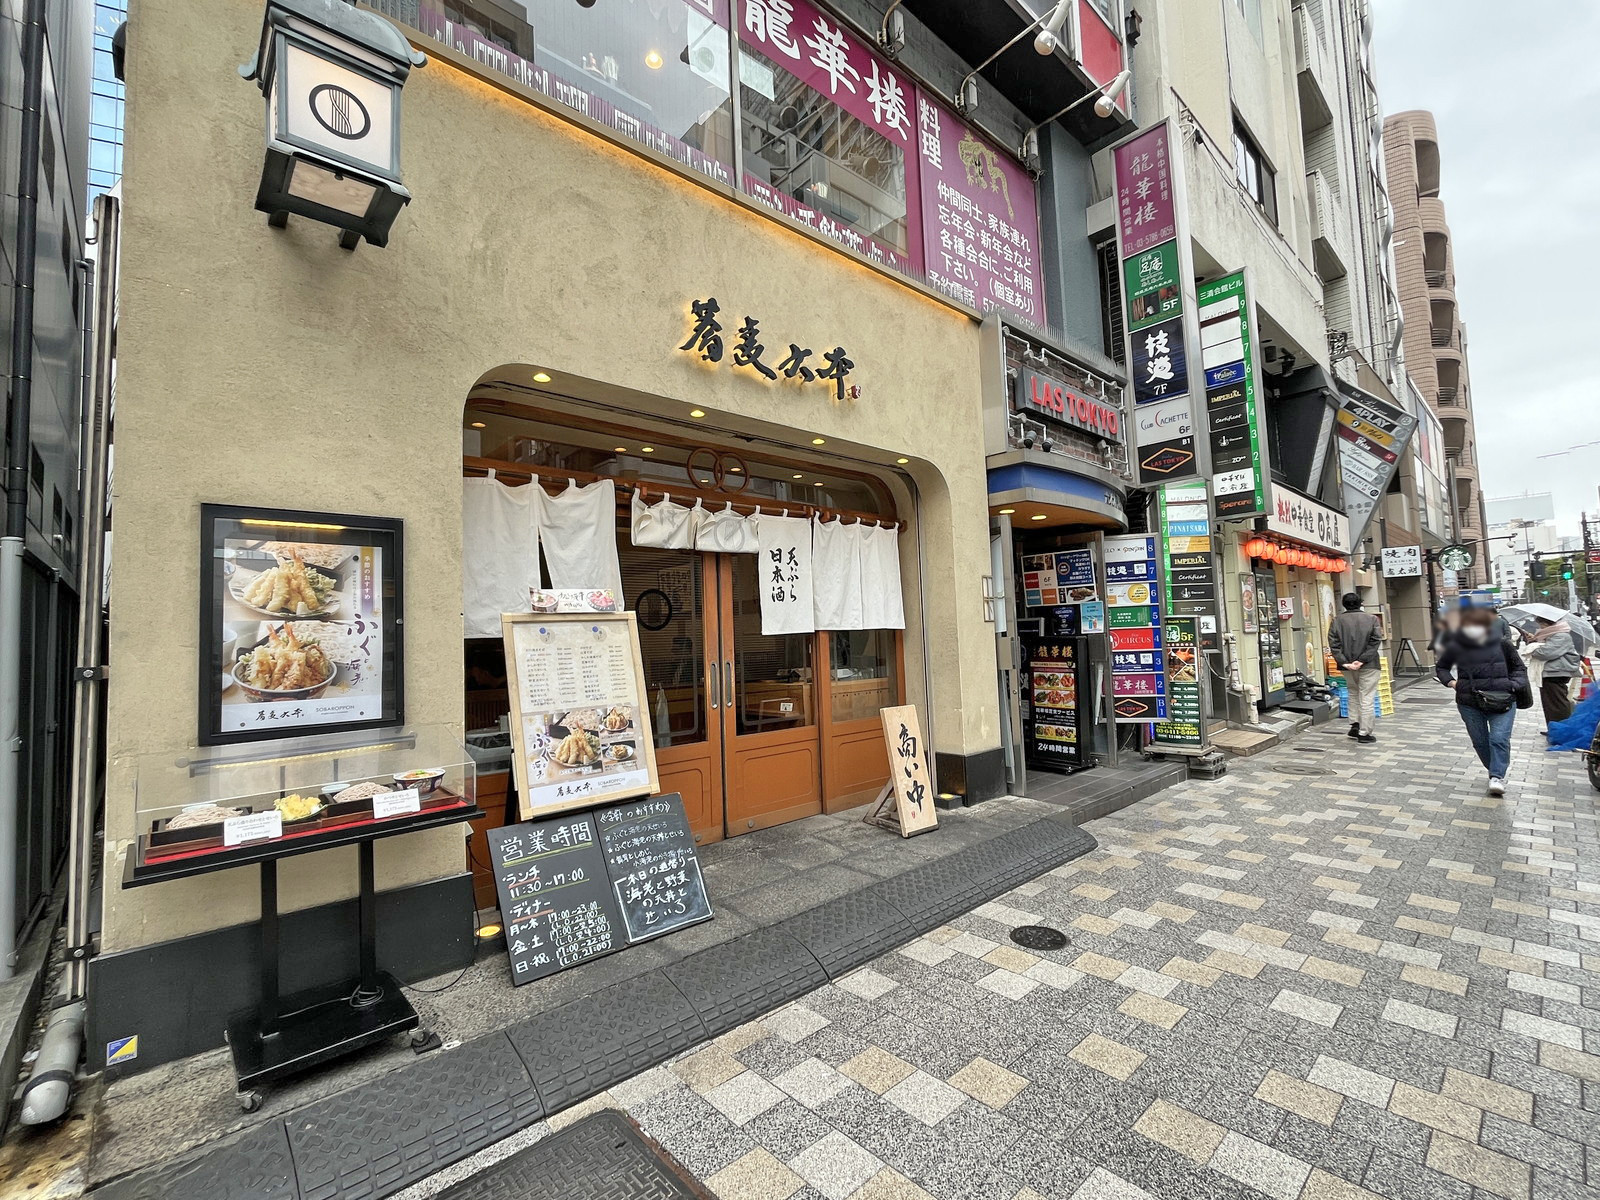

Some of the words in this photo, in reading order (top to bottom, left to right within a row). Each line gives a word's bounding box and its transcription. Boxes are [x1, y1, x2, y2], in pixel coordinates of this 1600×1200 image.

[919, 98, 942, 170] 料理
[1129, 152, 1158, 226] 龍華楼
[937, 180, 1030, 252] 仲間同士、家族連れ
[937, 204, 1032, 274] 忘年会・新年会など
[940, 229, 1033, 294] 各種会合に、ご利用
[940, 251, 979, 287] 下さい。
[1162, 298, 1179, 311] 5F
[1240, 299, 1246, 308] 9
[1242, 321, 1248, 330] 8
[1243, 342, 1249, 352] 7
[1246, 364, 1251, 373] 6
[1153, 383, 1168, 395] 7F
[1248, 385, 1254, 395] 5
[1211, 389, 1242, 403] IMPERIAL
[1030, 375, 1064, 413] LAS
[1066, 391, 1119, 435] TOKYO
[1249, 409, 1255, 417] 4
[1353, 407, 1391, 428] 4PLAY
[1140, 418, 1154, 431] CLUB
[1179, 425, 1191, 434] 6F
[1251, 428, 1257, 438] 3
[1182, 437, 1191, 446] B1
[1163, 456, 1185, 466] TOKYO
[1253, 451, 1259, 461] 2
[1255, 473, 1260, 482] 1
[1160, 494, 1165, 502] 9
[1162, 526, 1167, 534] 7
[1169, 524, 1206, 533] PINAISARA
[1163, 542, 1168, 550] 6
[1385, 548, 1417, 558] 焼肉
[1174, 555, 1207, 565] IMPERIAL
[769, 548, 785, 603] 日本酒
[787, 547, 799, 603] 天ぷら
[1166, 574, 1171, 582] 4
[1167, 590, 1172, 598] 3
[1168, 606, 1173, 614] 2
[1181, 632, 1194, 641] 5F
[1157, 680, 1163, 688] 2
[1037, 742, 1076, 755] 24時間営業
[500, 821, 592, 862] 営業時間
[626, 870, 690, 904] 海老と野菜
[645, 898, 686, 924] せいろ
